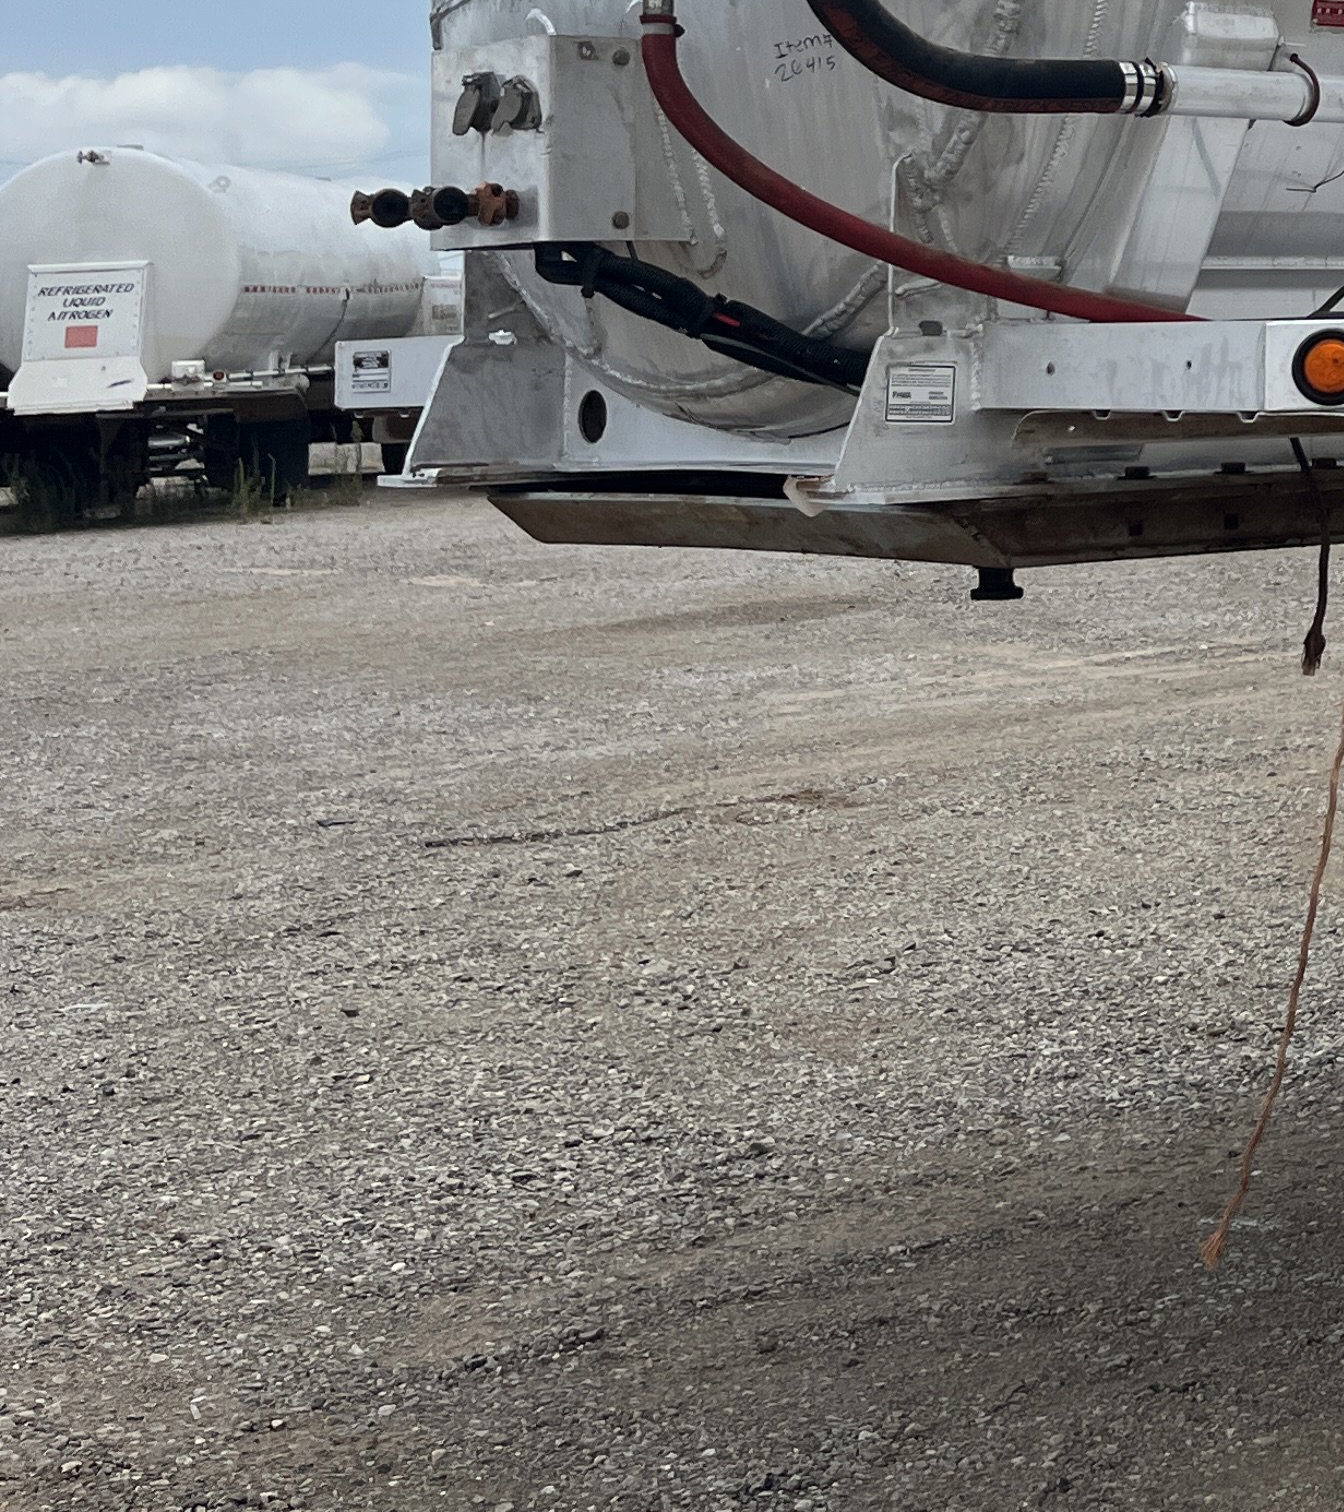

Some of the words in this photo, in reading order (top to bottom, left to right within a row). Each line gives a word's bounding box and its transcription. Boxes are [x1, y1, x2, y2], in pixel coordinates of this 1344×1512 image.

[38, 283, 134, 296] REFRIGERATED
[63, 296, 106, 308] LIQUID
[47, 309, 113, 322] NITROGEN
